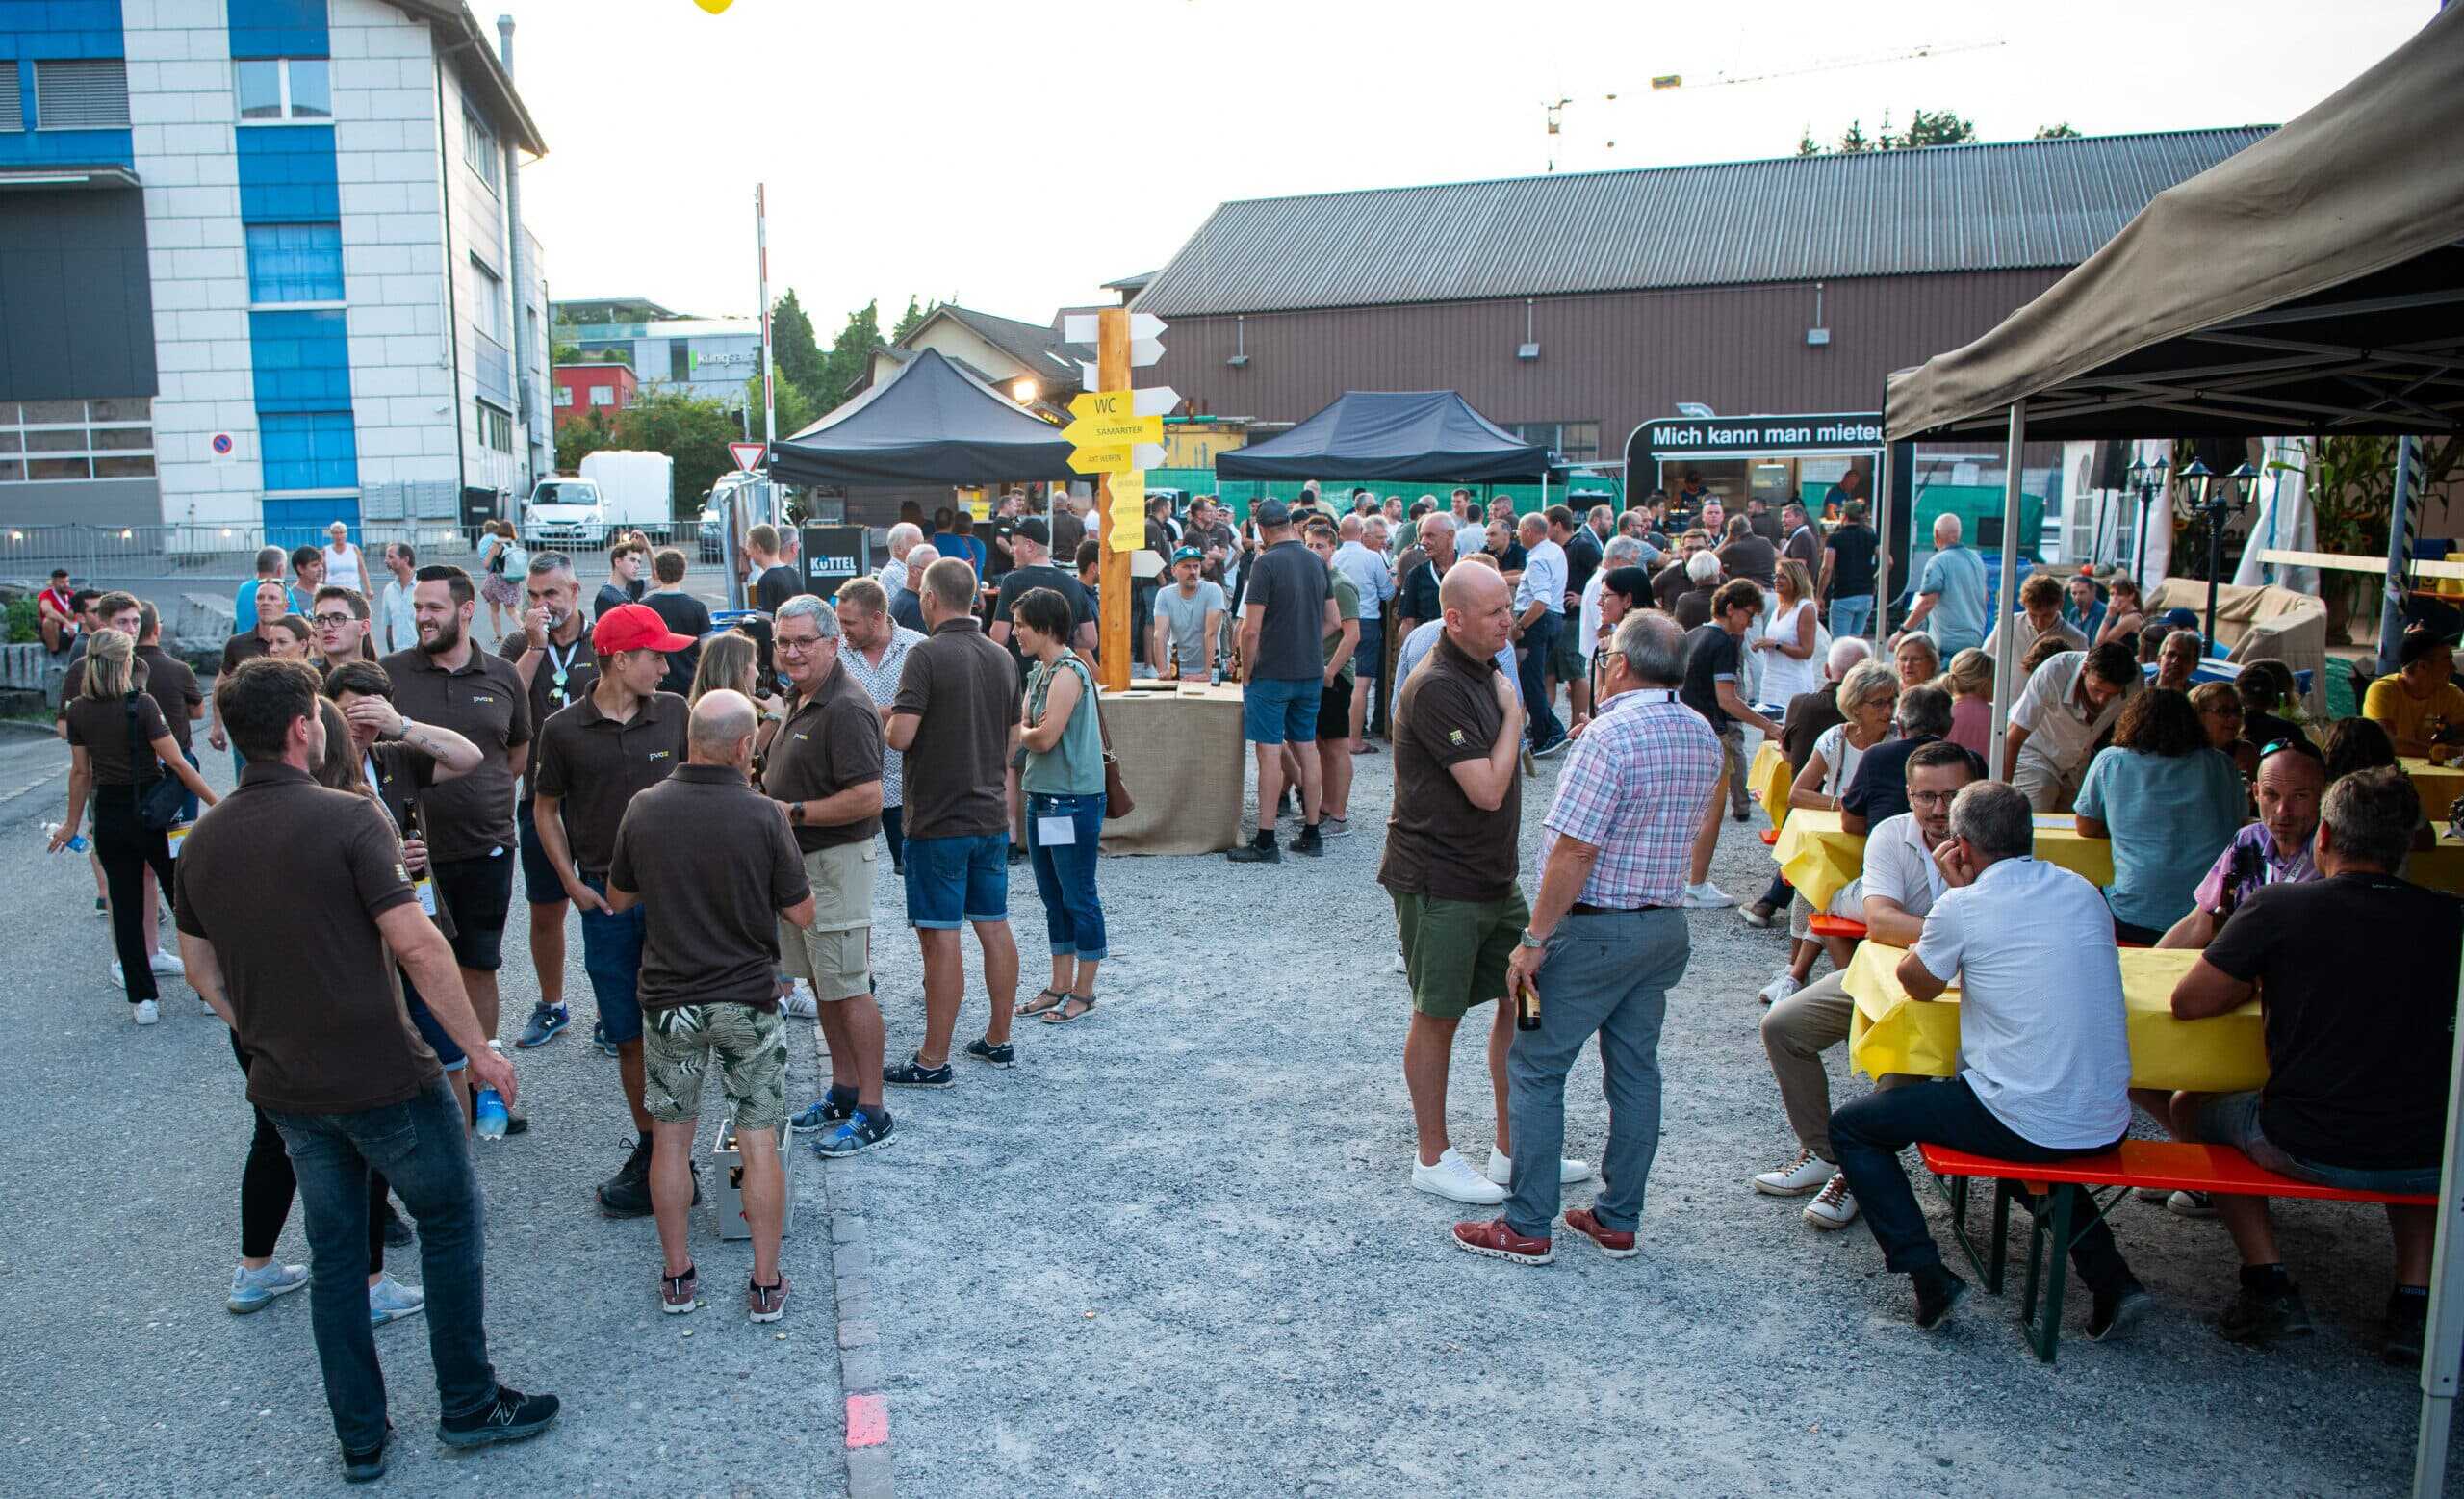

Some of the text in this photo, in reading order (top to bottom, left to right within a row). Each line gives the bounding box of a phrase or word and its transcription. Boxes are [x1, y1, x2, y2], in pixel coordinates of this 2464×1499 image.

[1094, 397, 1116, 413] WC
[1096, 426, 1143, 436] SAMARITER
[1653, 426, 1702, 445] Mich
[1707, 426, 1758, 444] kann
[1764, 427, 1810, 443] man
